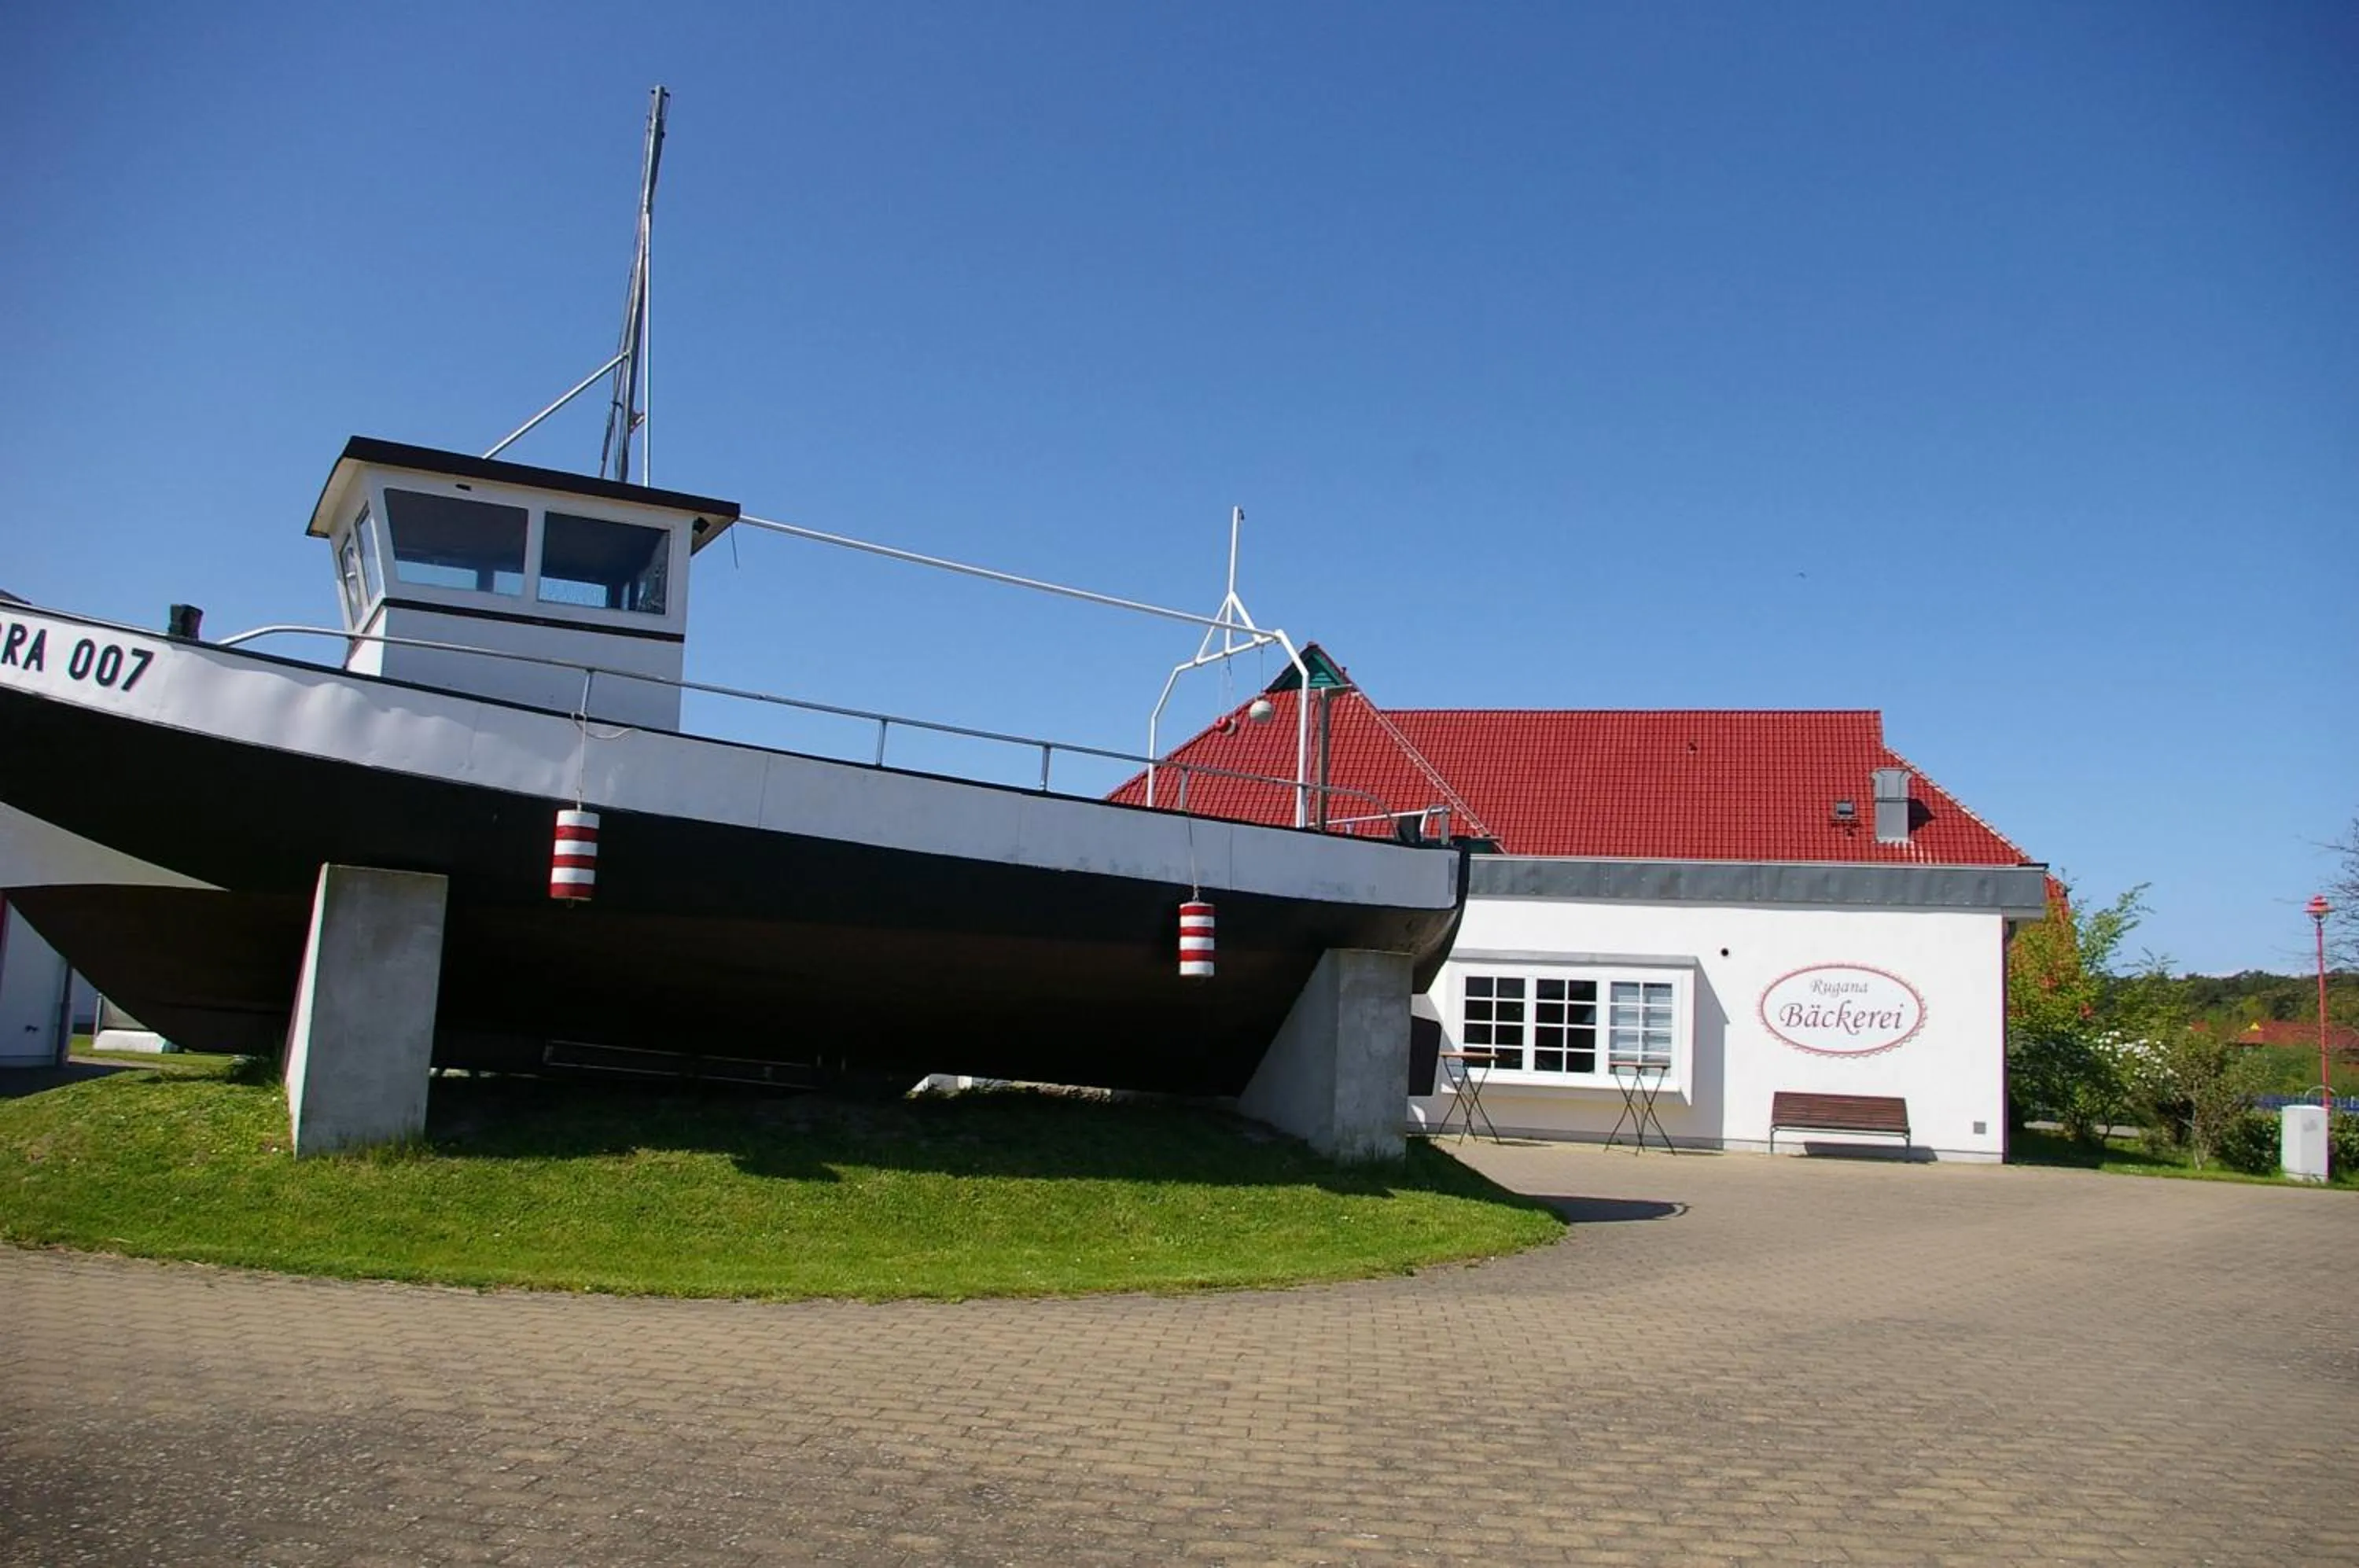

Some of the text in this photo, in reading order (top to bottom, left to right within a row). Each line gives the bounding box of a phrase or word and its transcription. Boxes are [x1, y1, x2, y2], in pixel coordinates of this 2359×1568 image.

[0, 621, 154, 691] RA 007
[1811, 978, 1868, 997] Rugana
[1779, 999, 1904, 1036] Bäckerei
